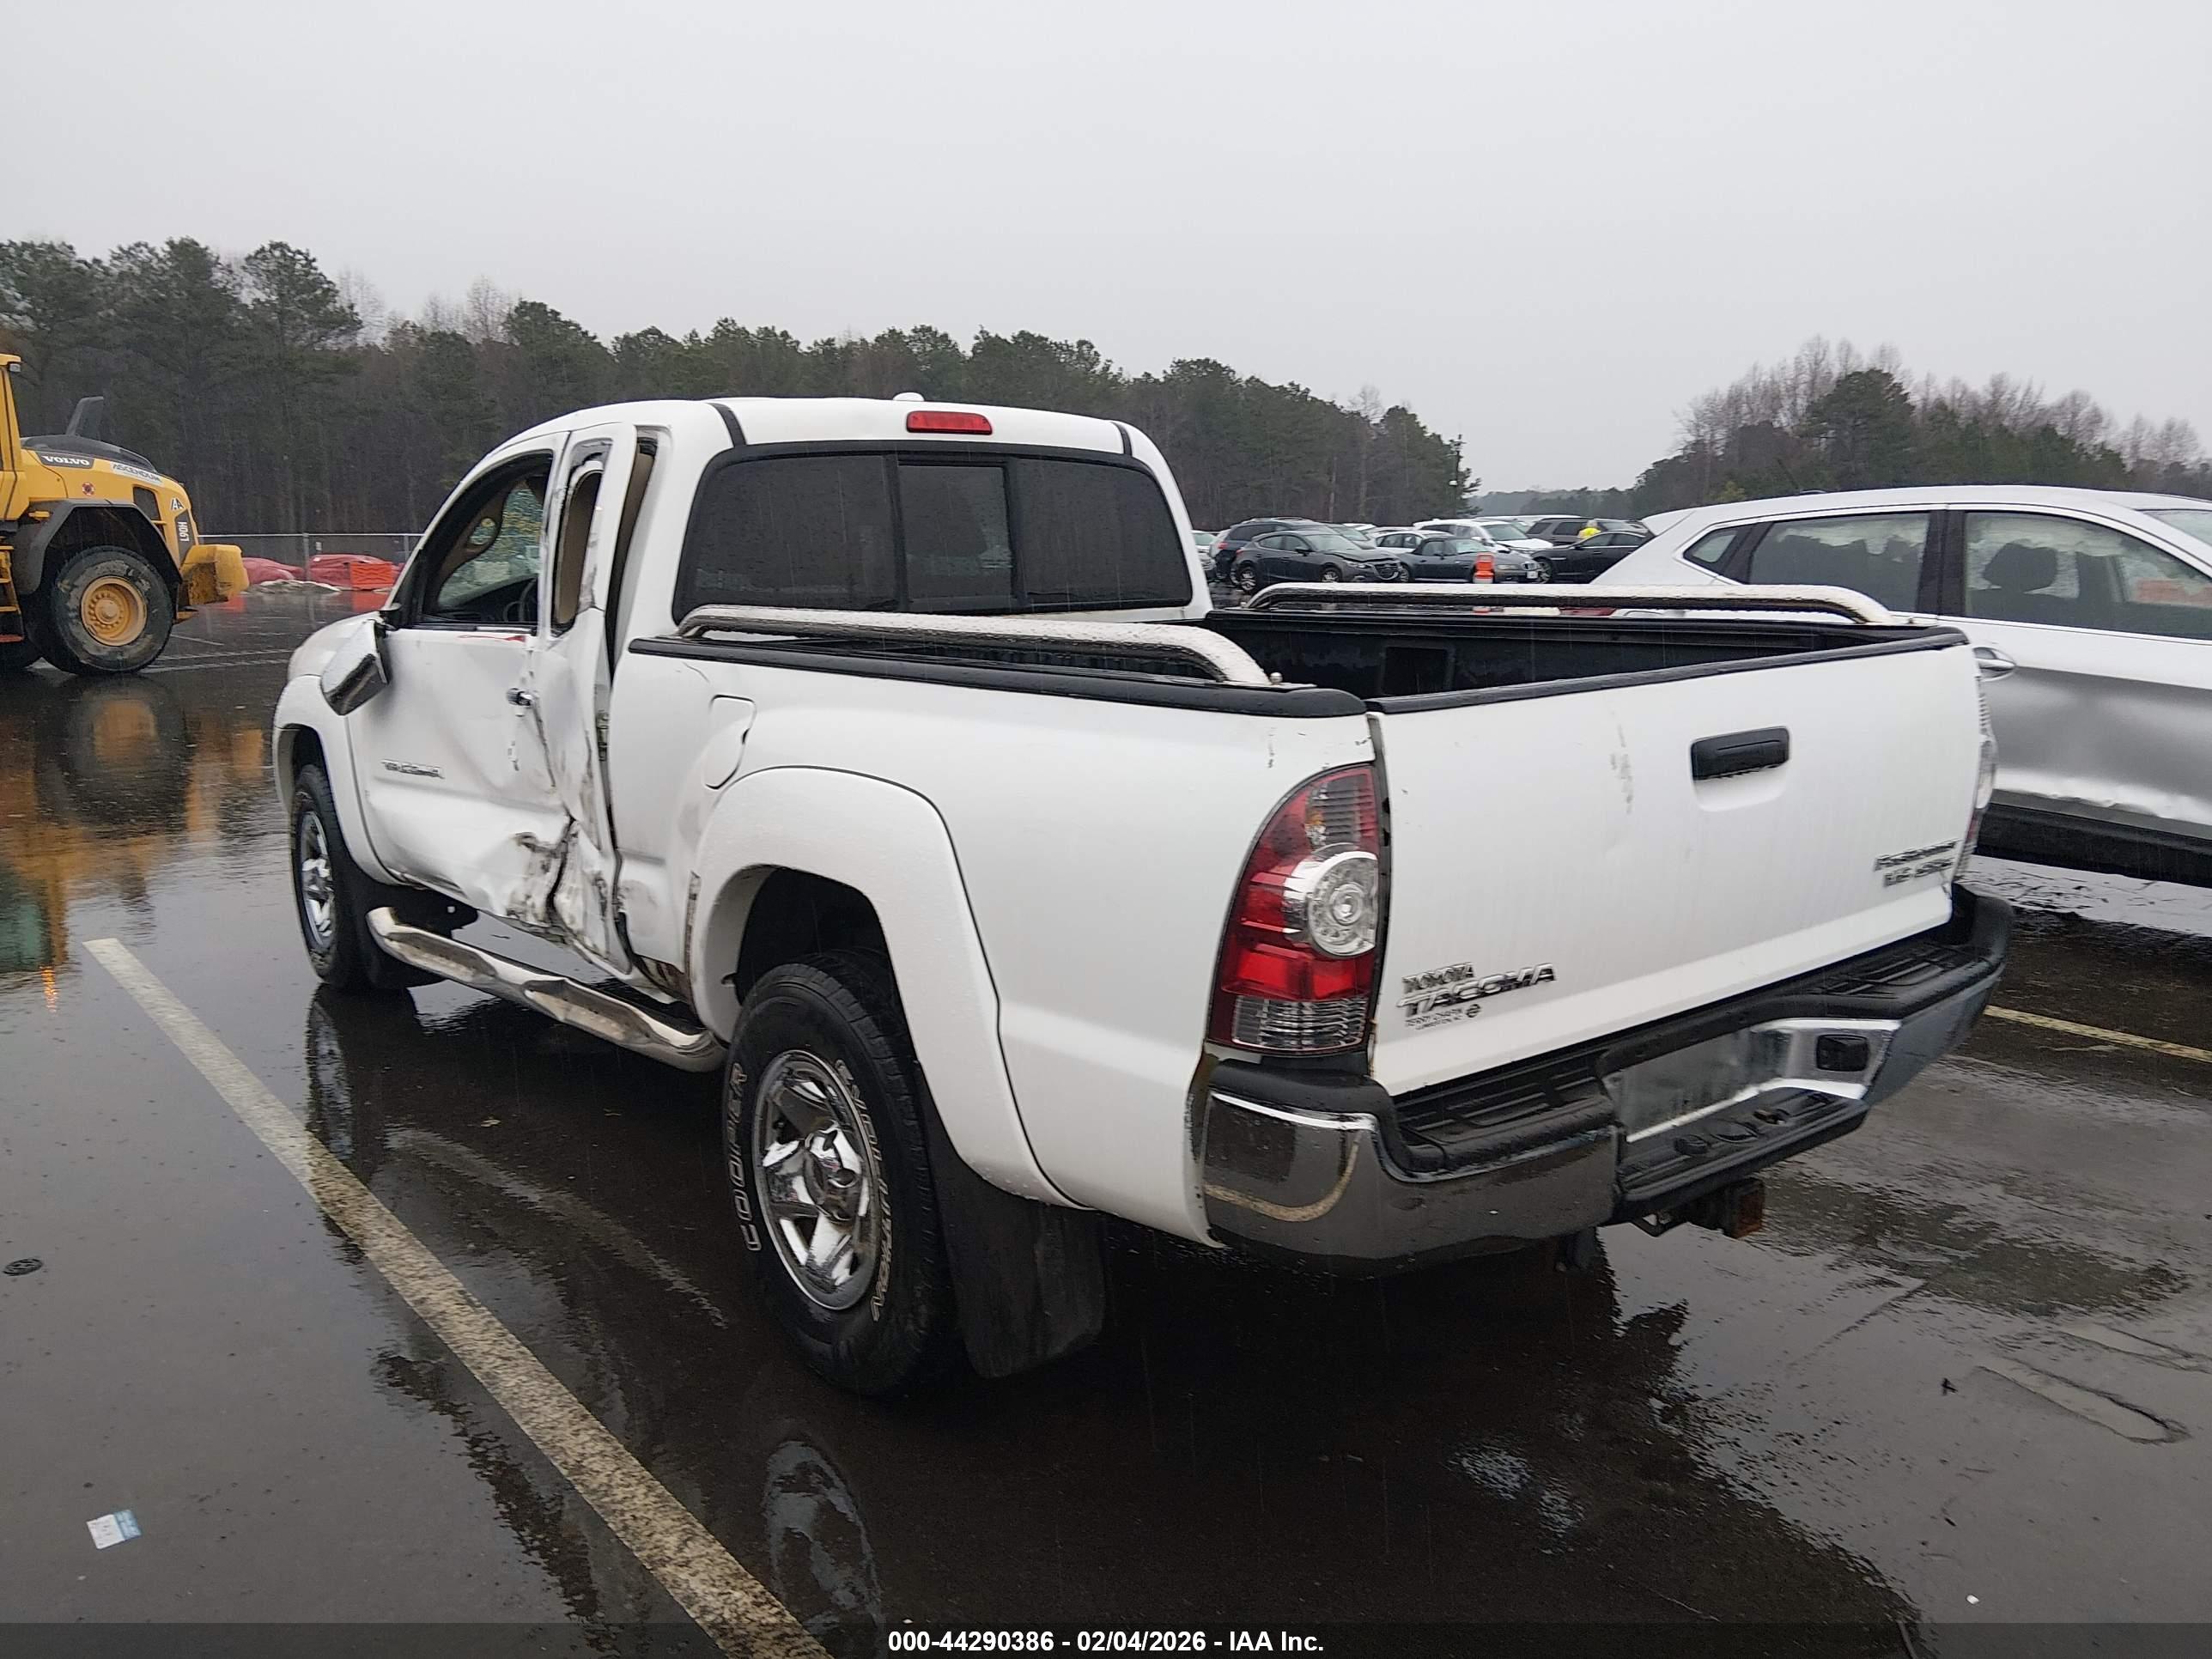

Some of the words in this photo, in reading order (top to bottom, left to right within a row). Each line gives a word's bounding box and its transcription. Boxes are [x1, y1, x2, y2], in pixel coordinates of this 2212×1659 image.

[42, 455, 90, 466] VOLVO
[178, 521, 190, 542] L90H
[1395, 963, 1558, 1017] TACOMA
[1401, 961, 1474, 994] TOYOTA
[727, 1061, 762, 1251] COOPER
